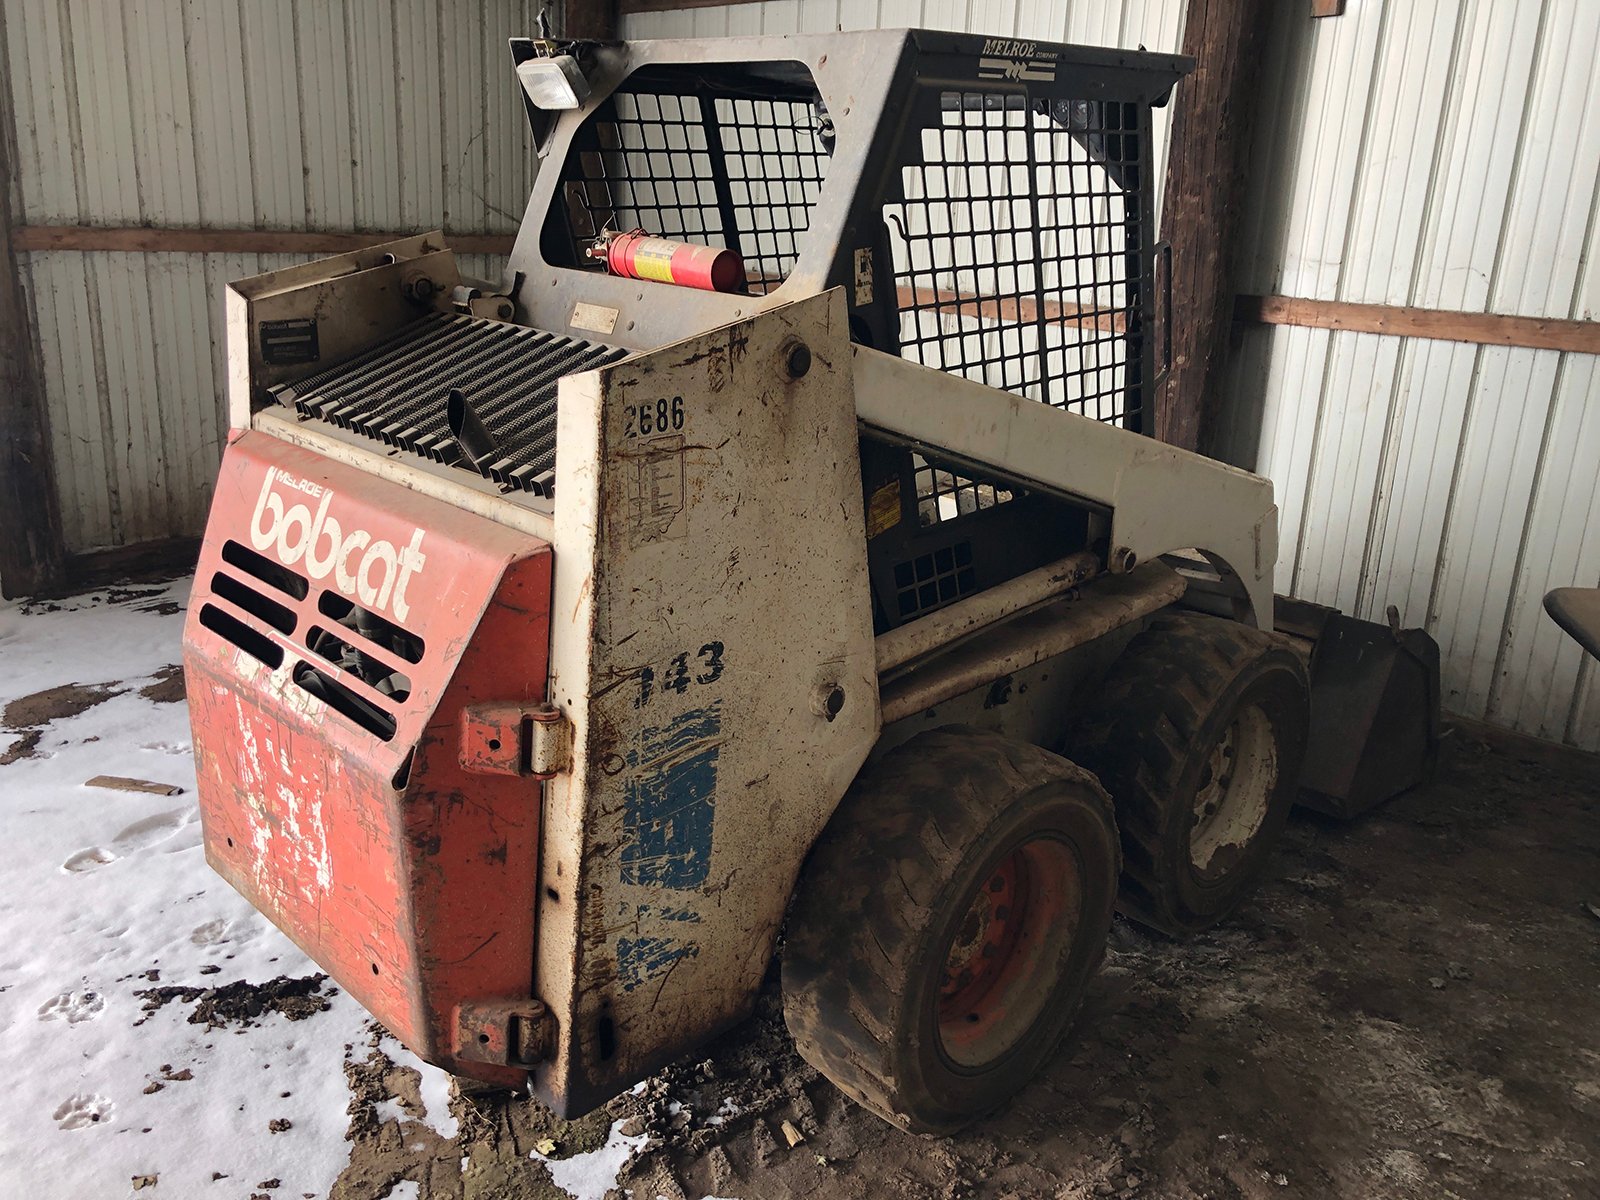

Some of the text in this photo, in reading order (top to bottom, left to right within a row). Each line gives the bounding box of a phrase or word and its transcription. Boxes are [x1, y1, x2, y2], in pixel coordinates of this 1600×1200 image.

[982, 39, 1036, 57] MELROE
[624, 396, 685, 438] 2686
[275, 469, 323, 498] MELROE
[250, 466, 427, 623] bobcat
